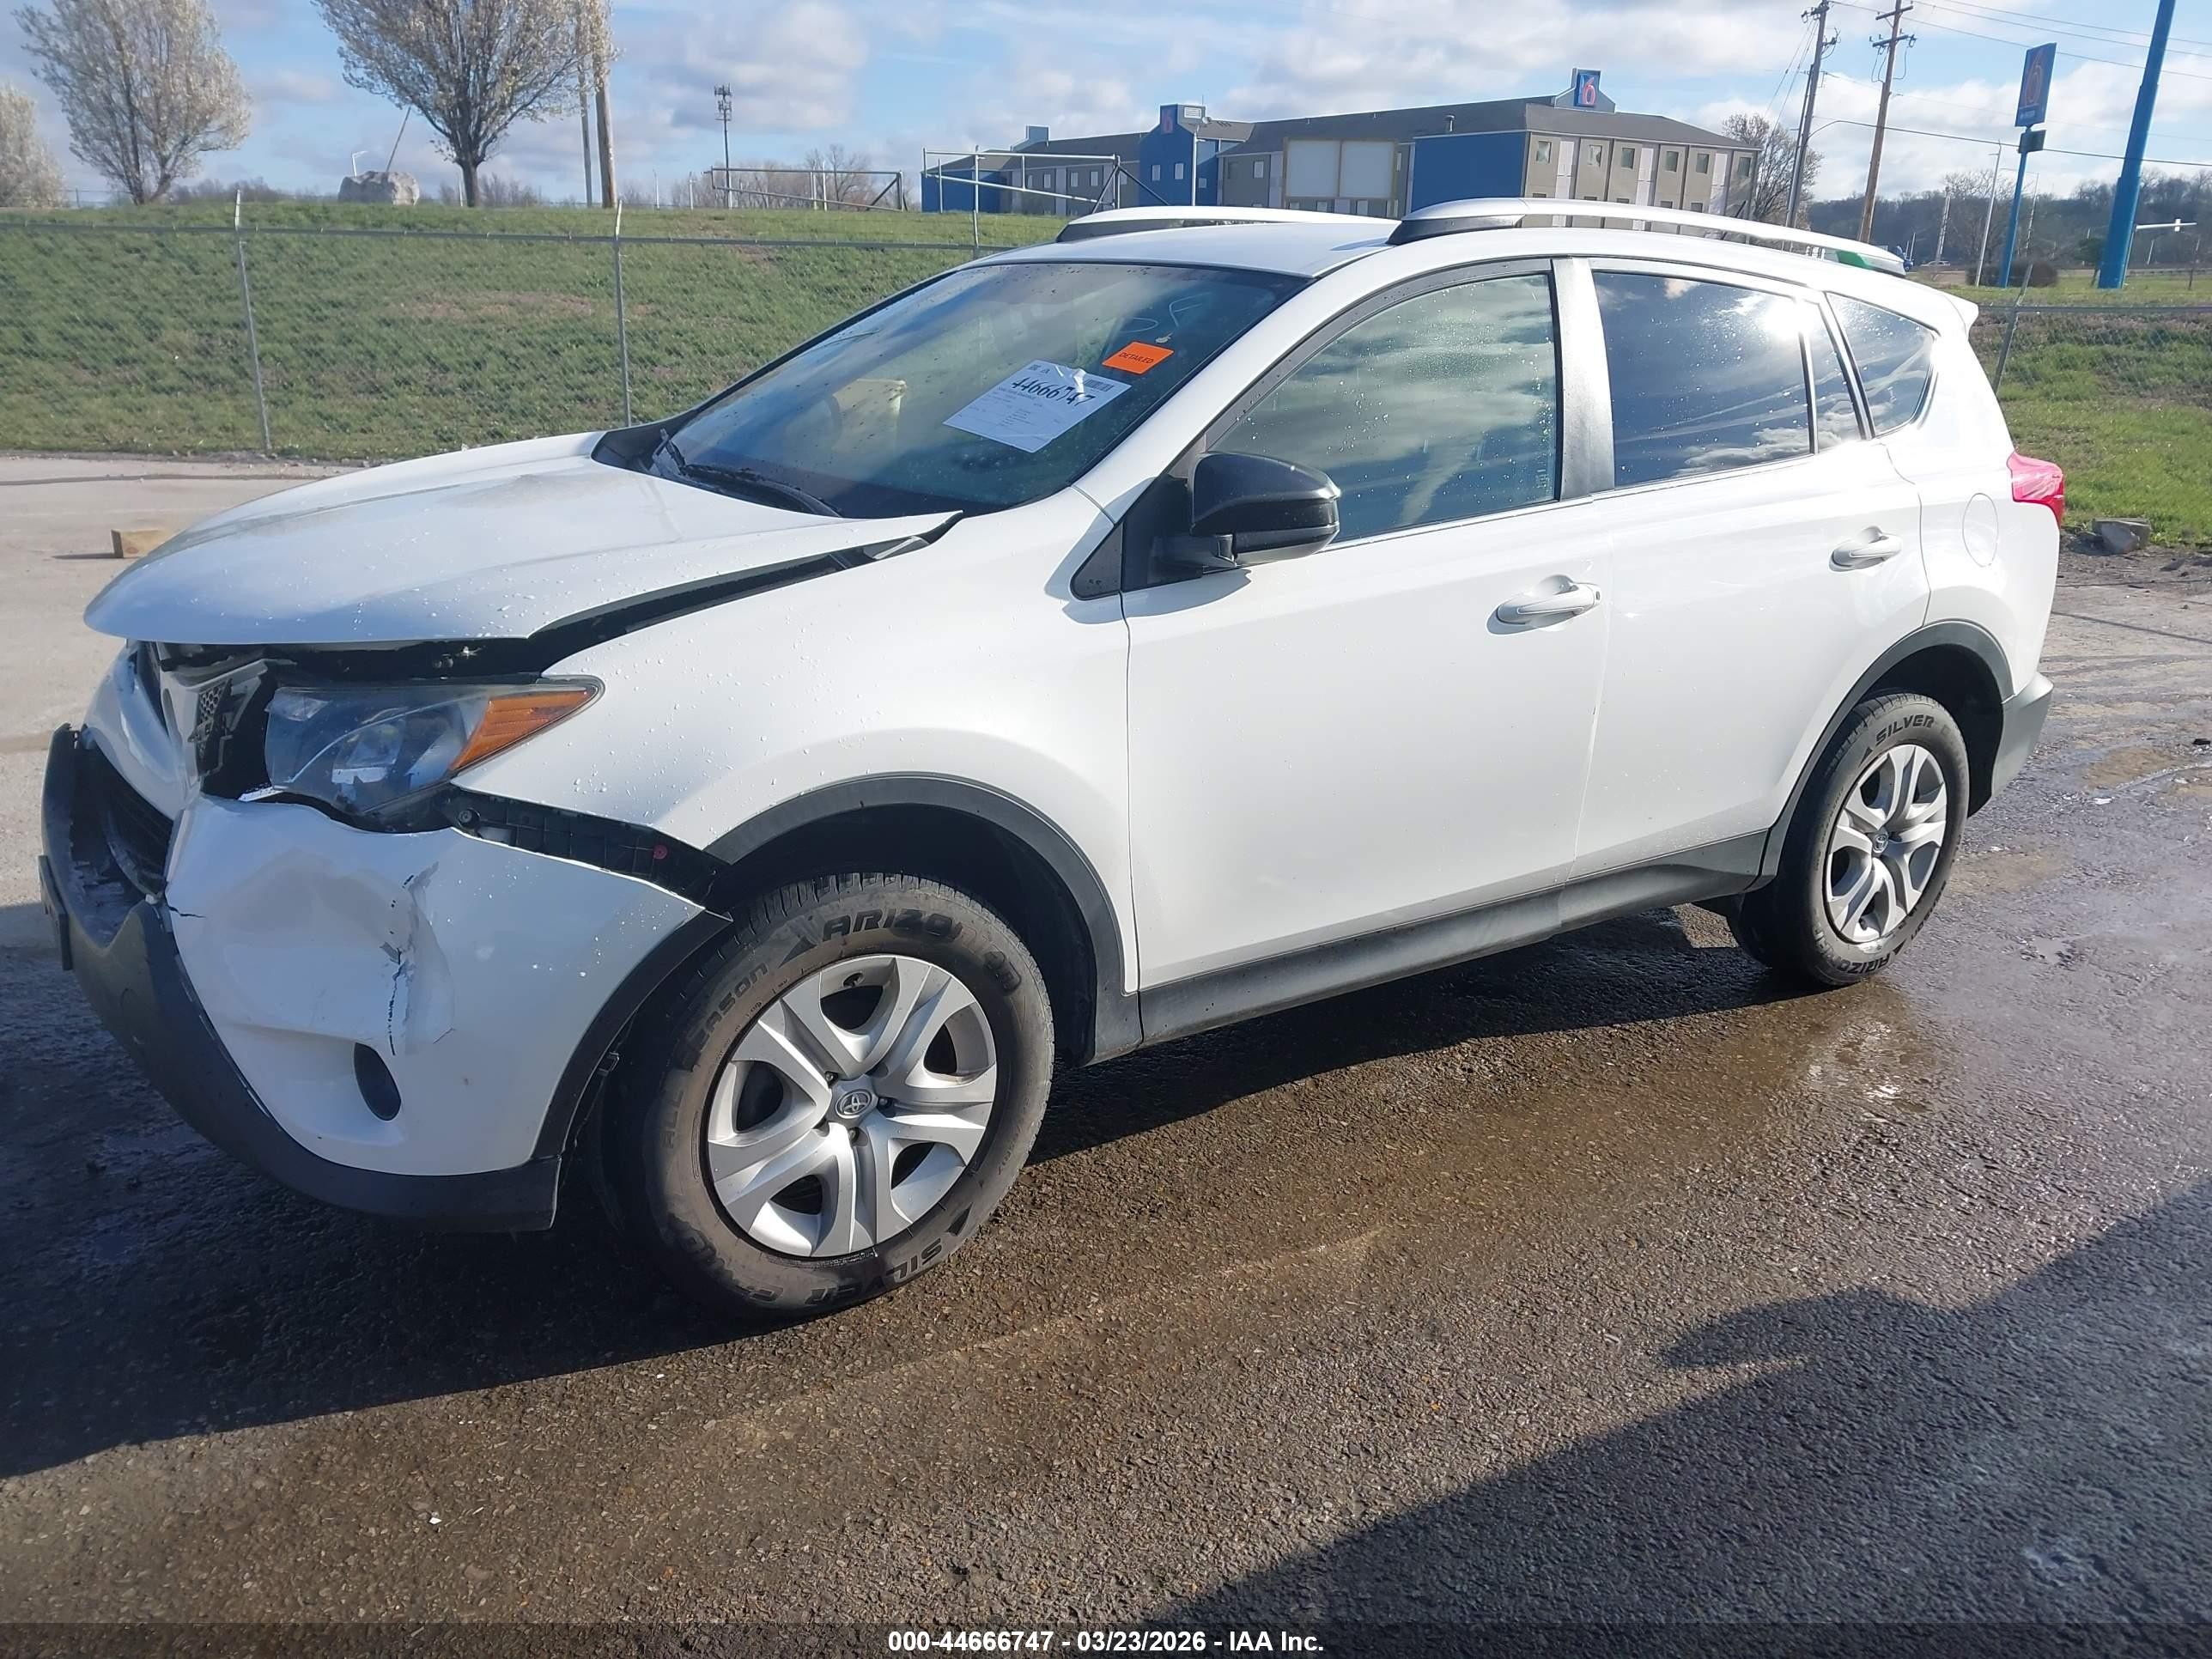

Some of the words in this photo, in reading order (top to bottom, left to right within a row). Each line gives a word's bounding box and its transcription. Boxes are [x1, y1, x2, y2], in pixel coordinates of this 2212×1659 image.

[1582, 76, 1595, 105] 6
[1118, 351, 1155, 365] DETAILED
[1012, 377, 1097, 407] 44666747
[1875, 714, 1936, 746] SILVER
